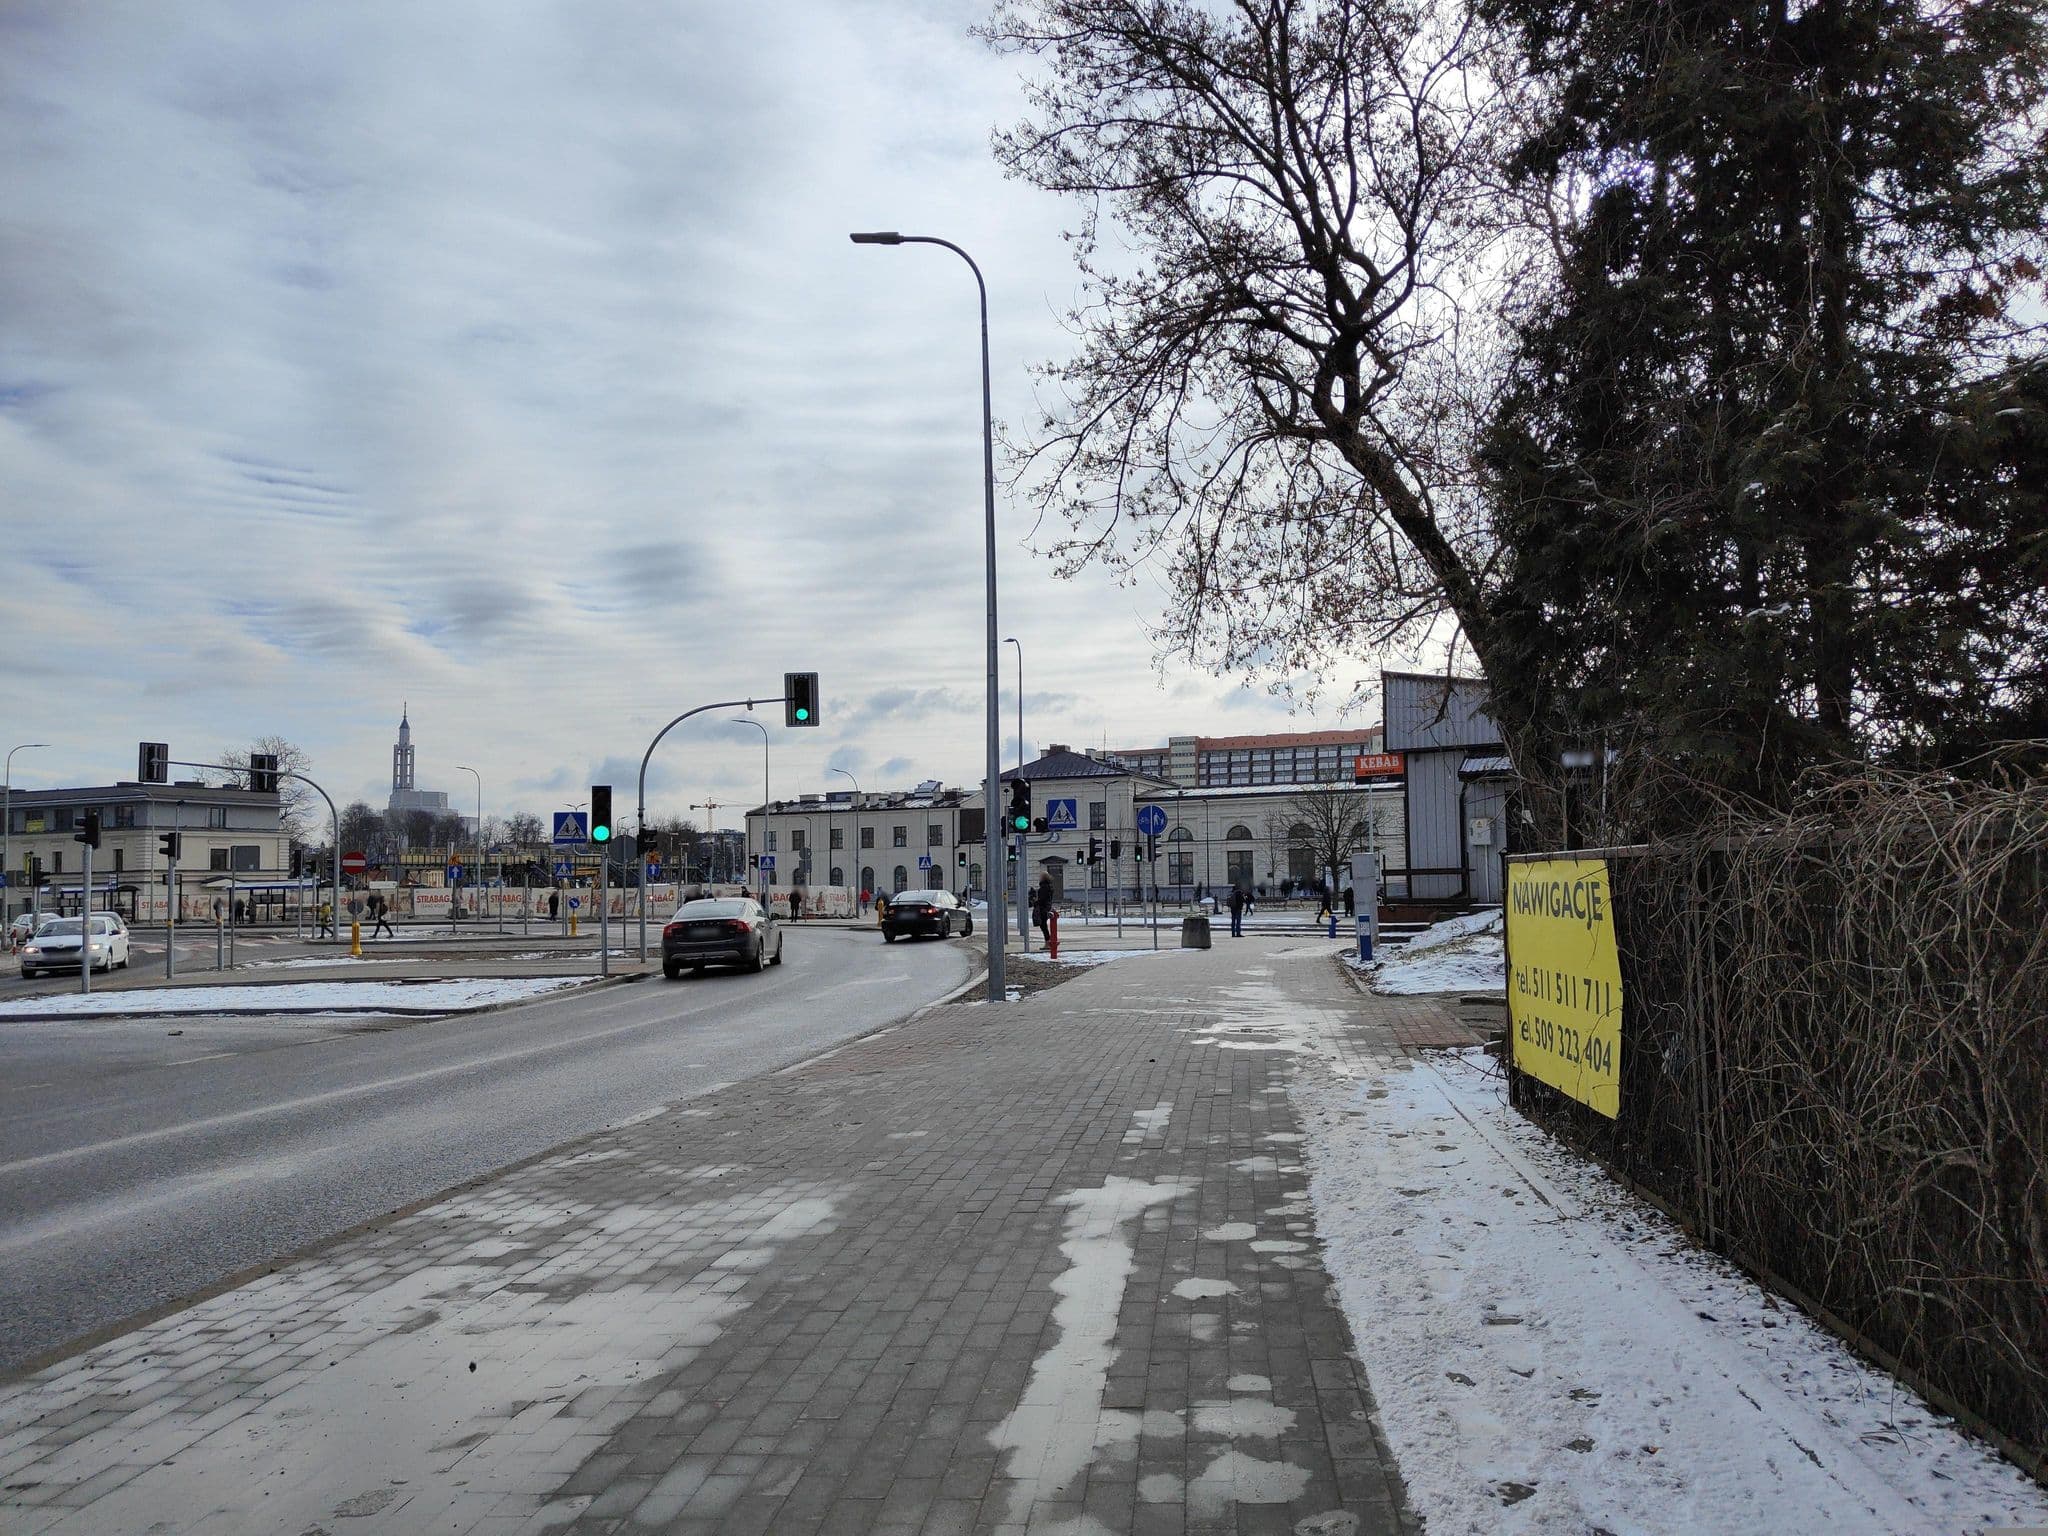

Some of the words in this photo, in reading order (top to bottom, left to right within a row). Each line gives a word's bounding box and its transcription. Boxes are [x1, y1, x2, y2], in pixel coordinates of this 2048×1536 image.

[1360, 755, 1399, 769] KEBAB
[416, 895, 450, 903] STRABAG
[1513, 881, 1603, 930] NAWIGACJE
[1555, 970, 1577, 1008] 511
[1583, 979, 1611, 1018] 711
[1557, 1024, 1581, 1065] 323
[1585, 1037, 1612, 1077] 404
